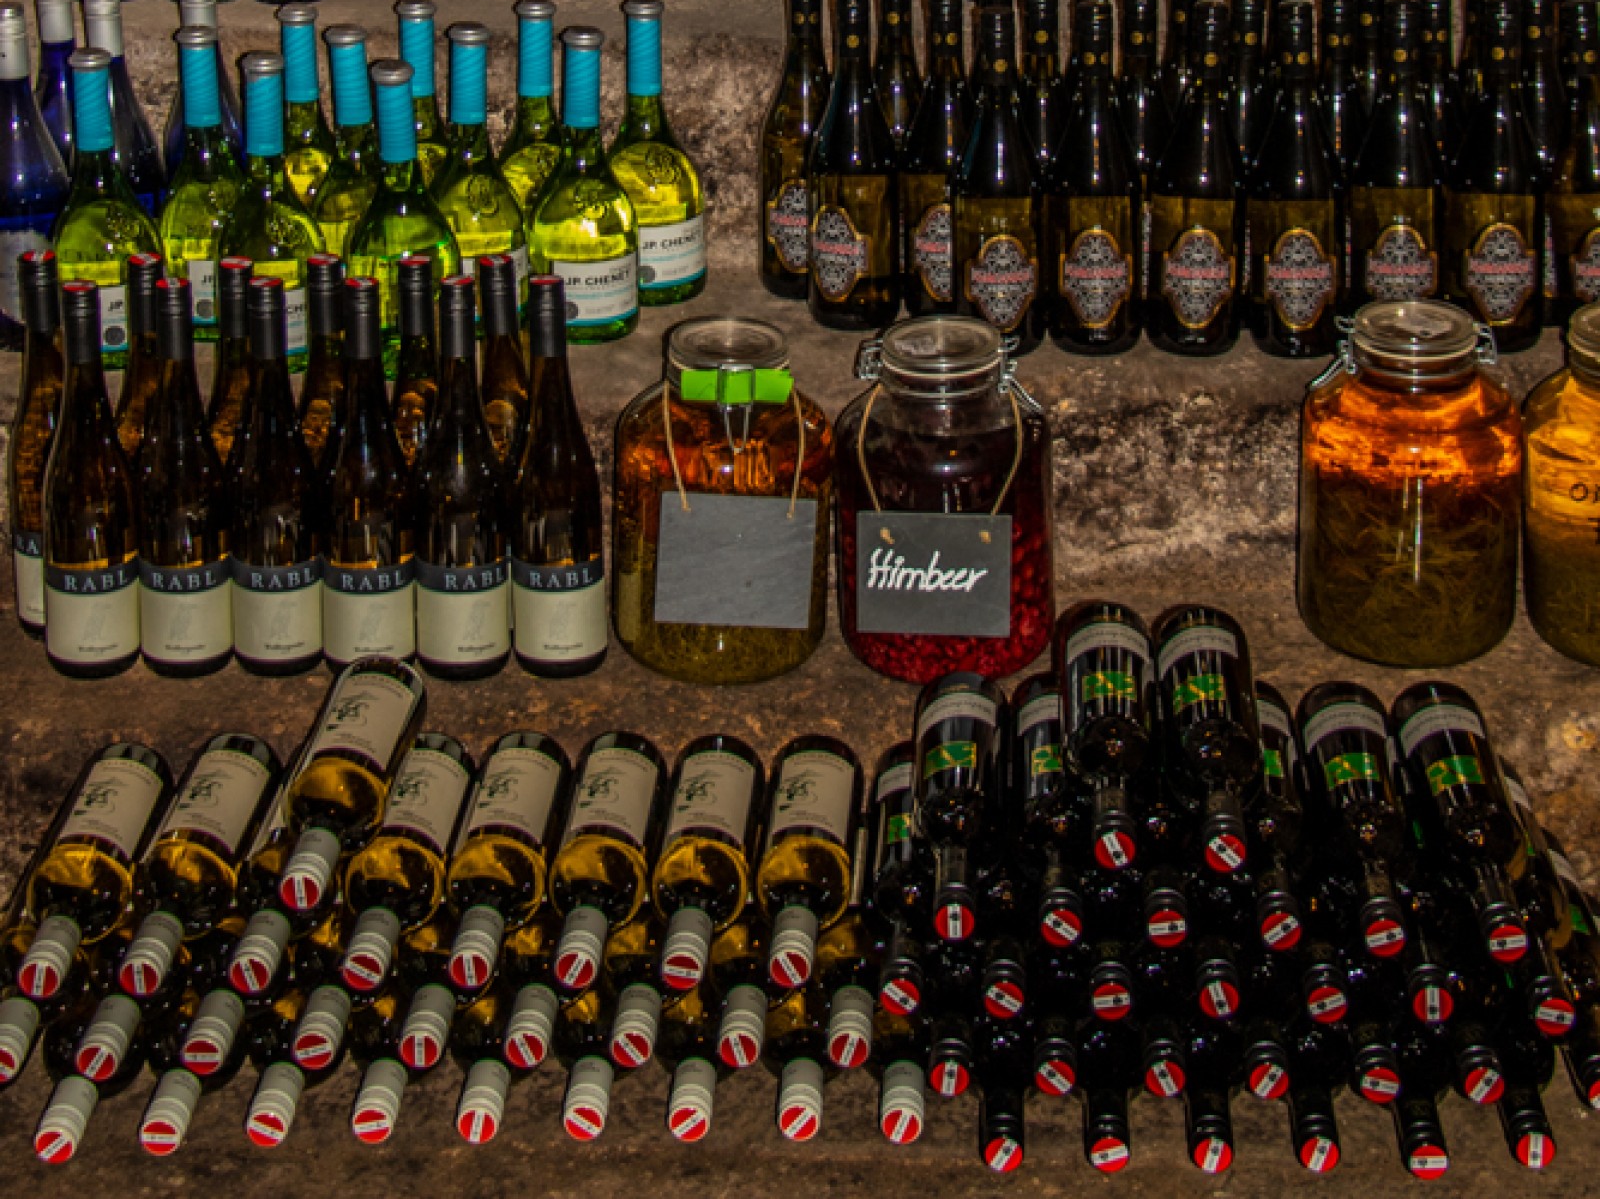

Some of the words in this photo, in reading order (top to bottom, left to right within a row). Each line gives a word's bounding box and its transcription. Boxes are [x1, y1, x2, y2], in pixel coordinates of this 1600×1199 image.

[64, 569, 128, 592] RABL
[151, 569, 217, 591] RABL
[251, 567, 316, 589] RABL
[341, 569, 405, 591] RABL
[444, 567, 504, 590] RABL
[529, 567, 594, 589] RABL
[867, 548, 990, 592] Himbeer
